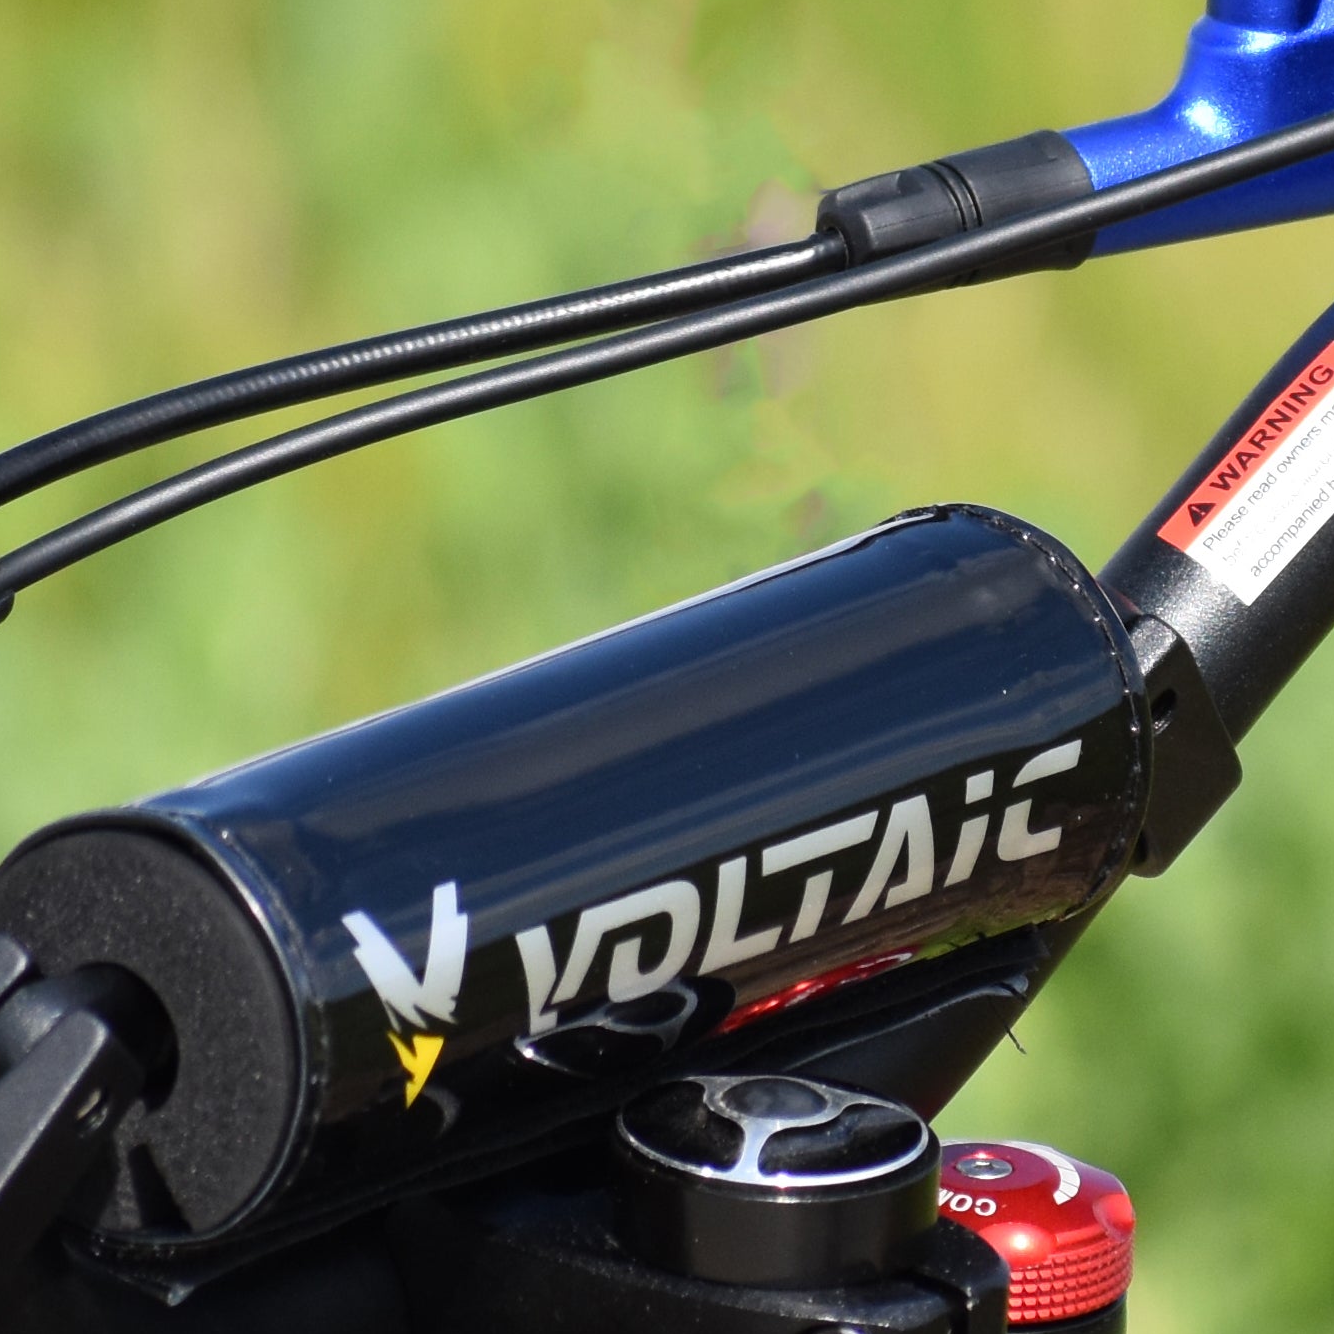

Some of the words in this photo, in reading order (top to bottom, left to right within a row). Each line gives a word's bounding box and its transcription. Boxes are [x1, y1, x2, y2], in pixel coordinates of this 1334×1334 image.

[1203, 505, 1249, 551] Please
[1248, 472, 1277, 507] read
[1277, 426, 1322, 474] owners
[1209, 364, 1334, 491] WARNING
[1250, 488, 1331, 578] accompanied
